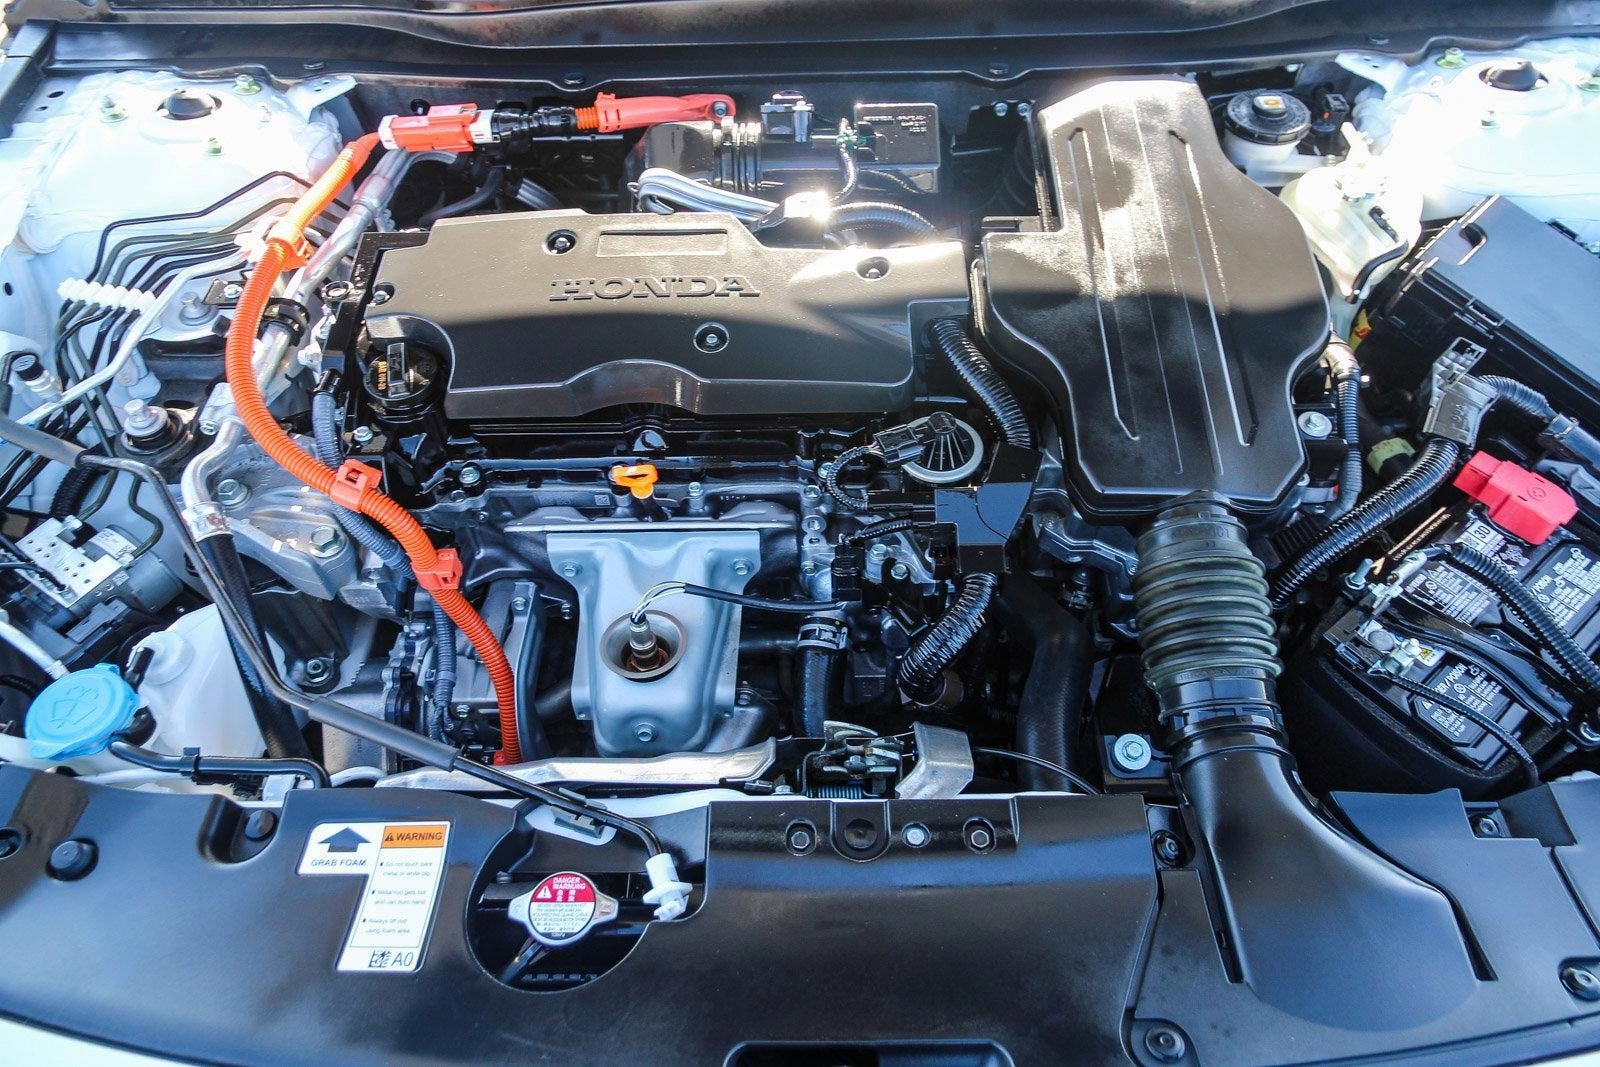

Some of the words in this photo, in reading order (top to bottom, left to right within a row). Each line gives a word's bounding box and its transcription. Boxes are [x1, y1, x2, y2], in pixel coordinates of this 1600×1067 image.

[548, 274, 761, 302] HONDA
[396, 832, 442, 841] WARNING
[311, 859, 337, 867] GRAB
[339, 859, 367, 867] FOAM
[553, 876, 581, 884] DANGER
